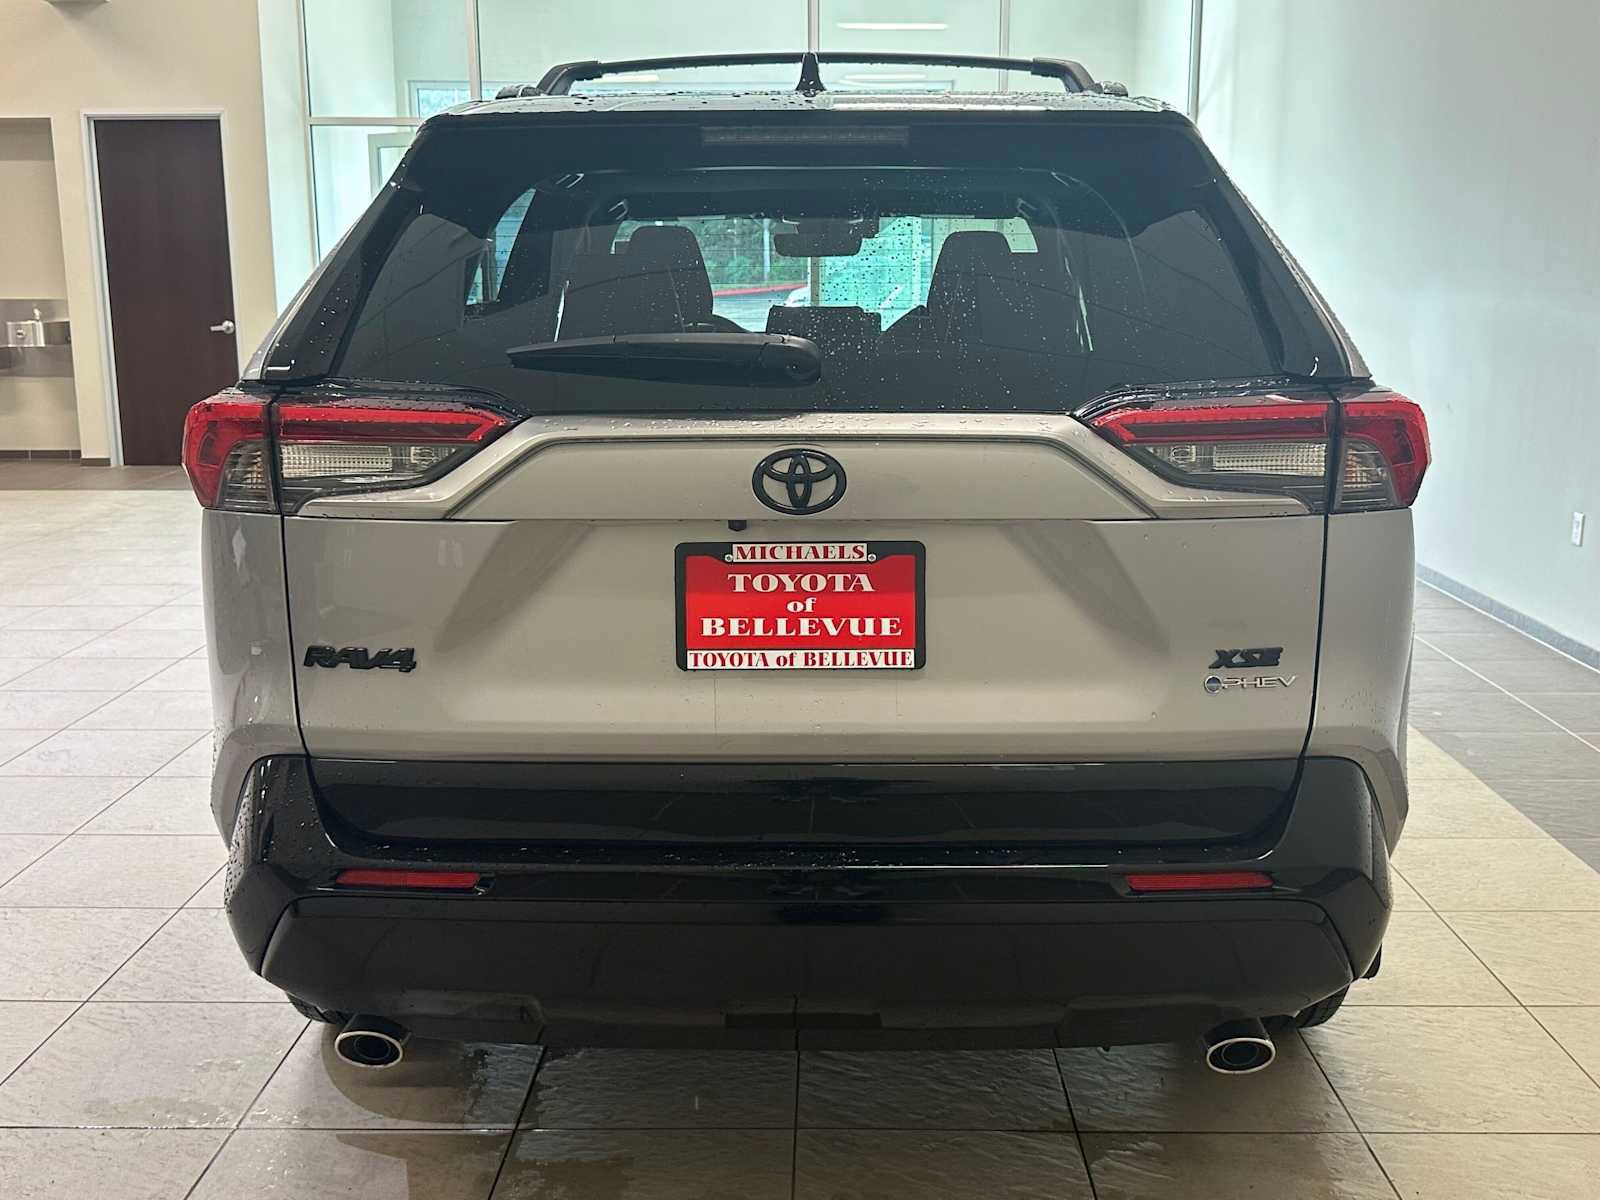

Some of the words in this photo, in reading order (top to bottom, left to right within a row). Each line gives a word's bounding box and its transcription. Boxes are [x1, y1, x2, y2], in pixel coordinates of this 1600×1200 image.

[735, 545, 866, 560] MICHAELS
[727, 573, 875, 593] TOYOTA
[786, 597, 817, 613] of
[700, 617, 902, 637] BELLEVUE
[303, 645, 416, 672] RAV4
[689, 652, 769, 667] TOYOTA
[776, 652, 798, 667] of
[803, 651, 913, 667] BELLEVUE
[1207, 646, 1283, 669] XSE
[1222, 675, 1297, 689] PHEV
